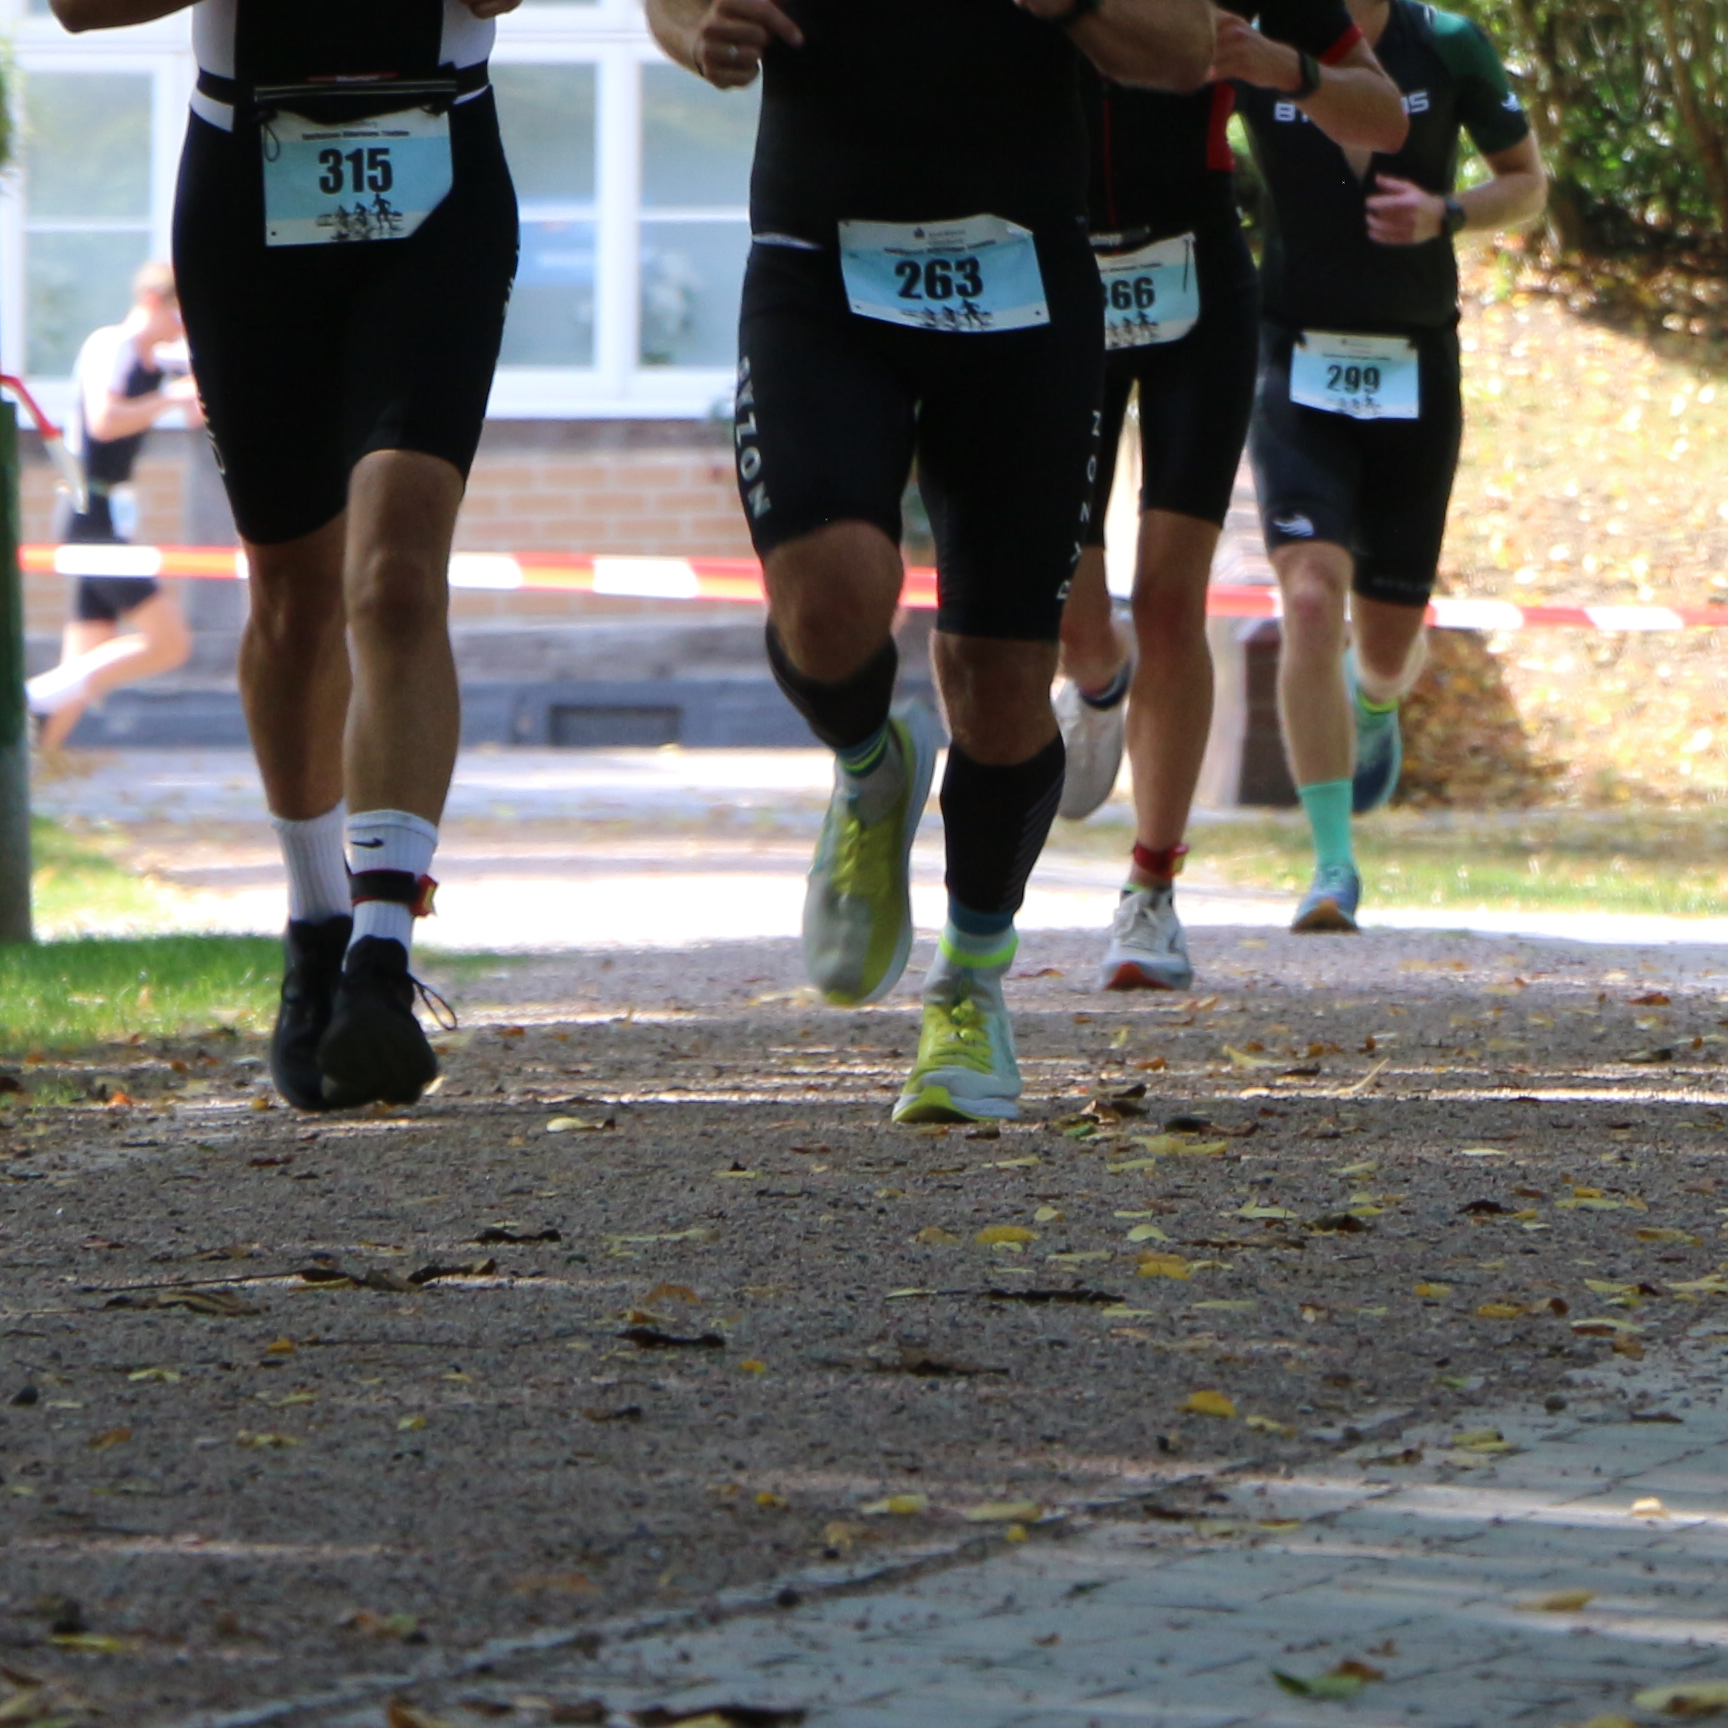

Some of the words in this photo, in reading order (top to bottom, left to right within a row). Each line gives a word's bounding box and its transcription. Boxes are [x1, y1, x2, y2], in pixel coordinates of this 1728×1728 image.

[318, 147, 393, 195] 315
[894, 256, 985, 301] 263
[1326, 364, 1380, 394] 299
